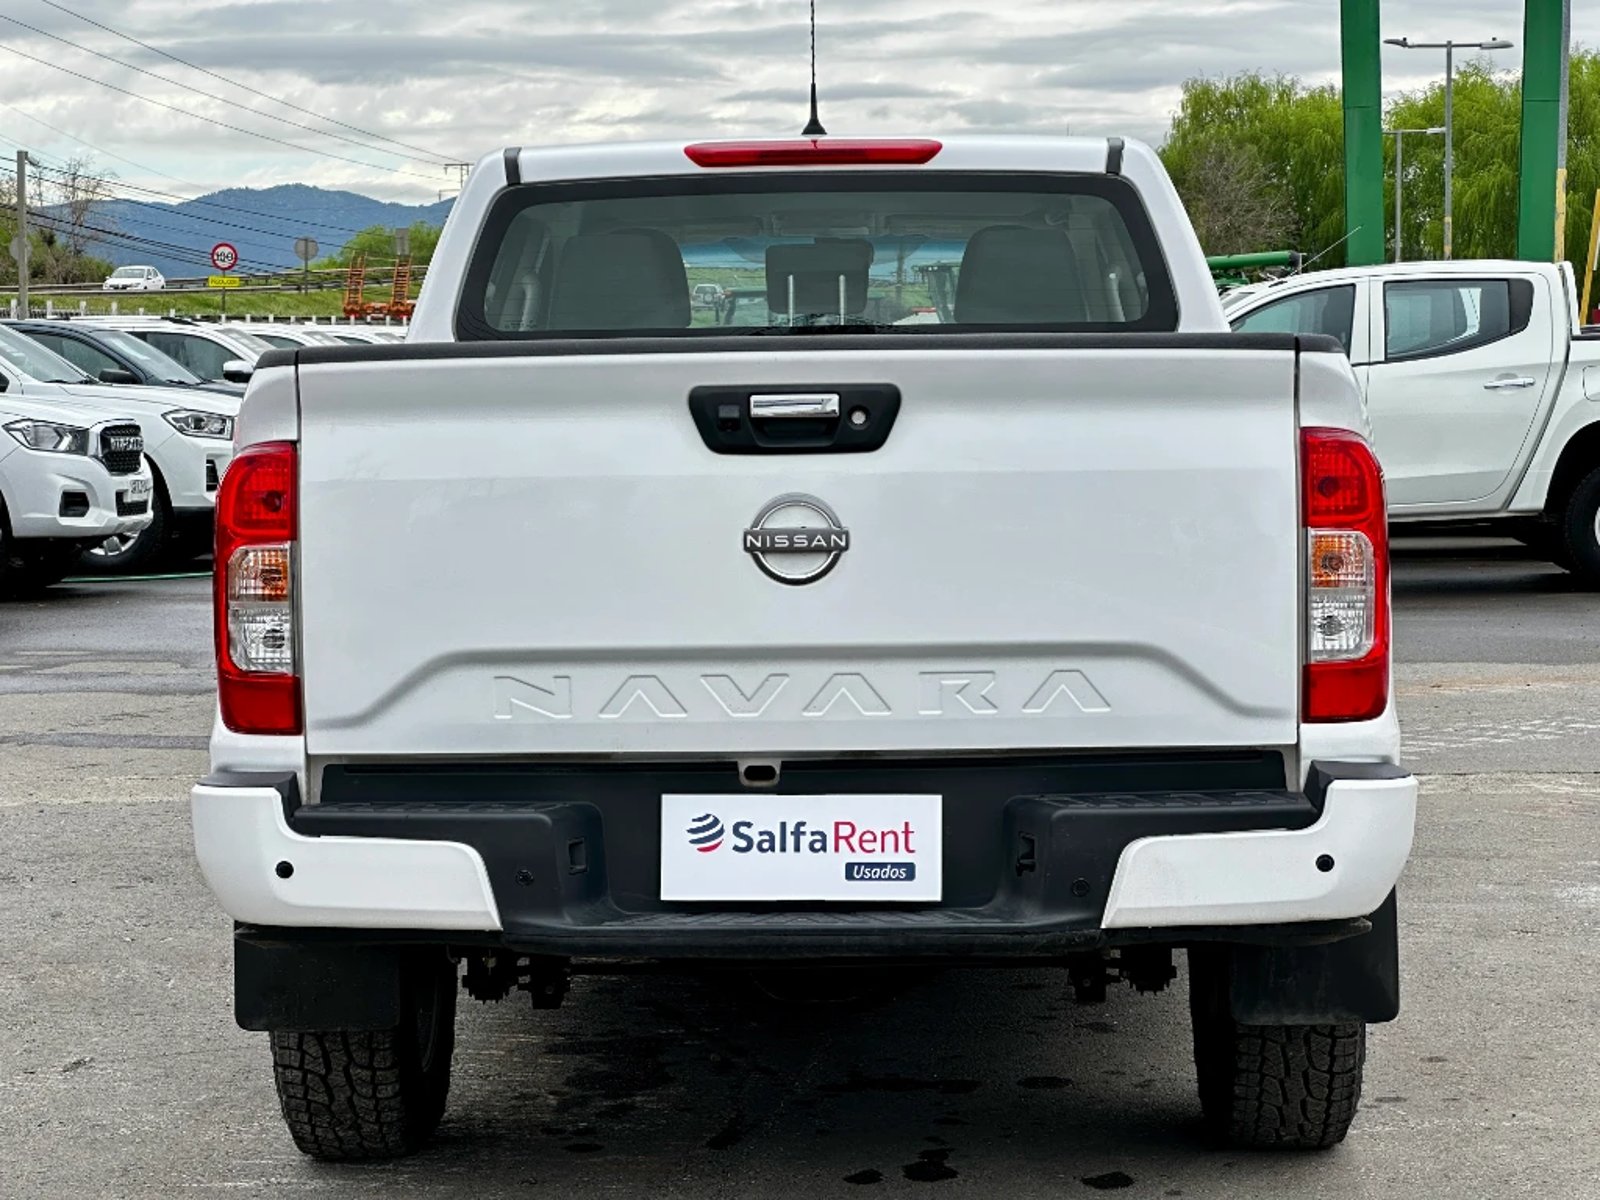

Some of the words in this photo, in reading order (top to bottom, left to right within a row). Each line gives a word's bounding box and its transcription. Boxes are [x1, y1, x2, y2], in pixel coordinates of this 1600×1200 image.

[746, 534, 846, 547] NISSAN
[493, 670, 1112, 718] NAVARA
[732, 821, 916, 853] SalfaRent
[853, 865, 906, 879] Usados
